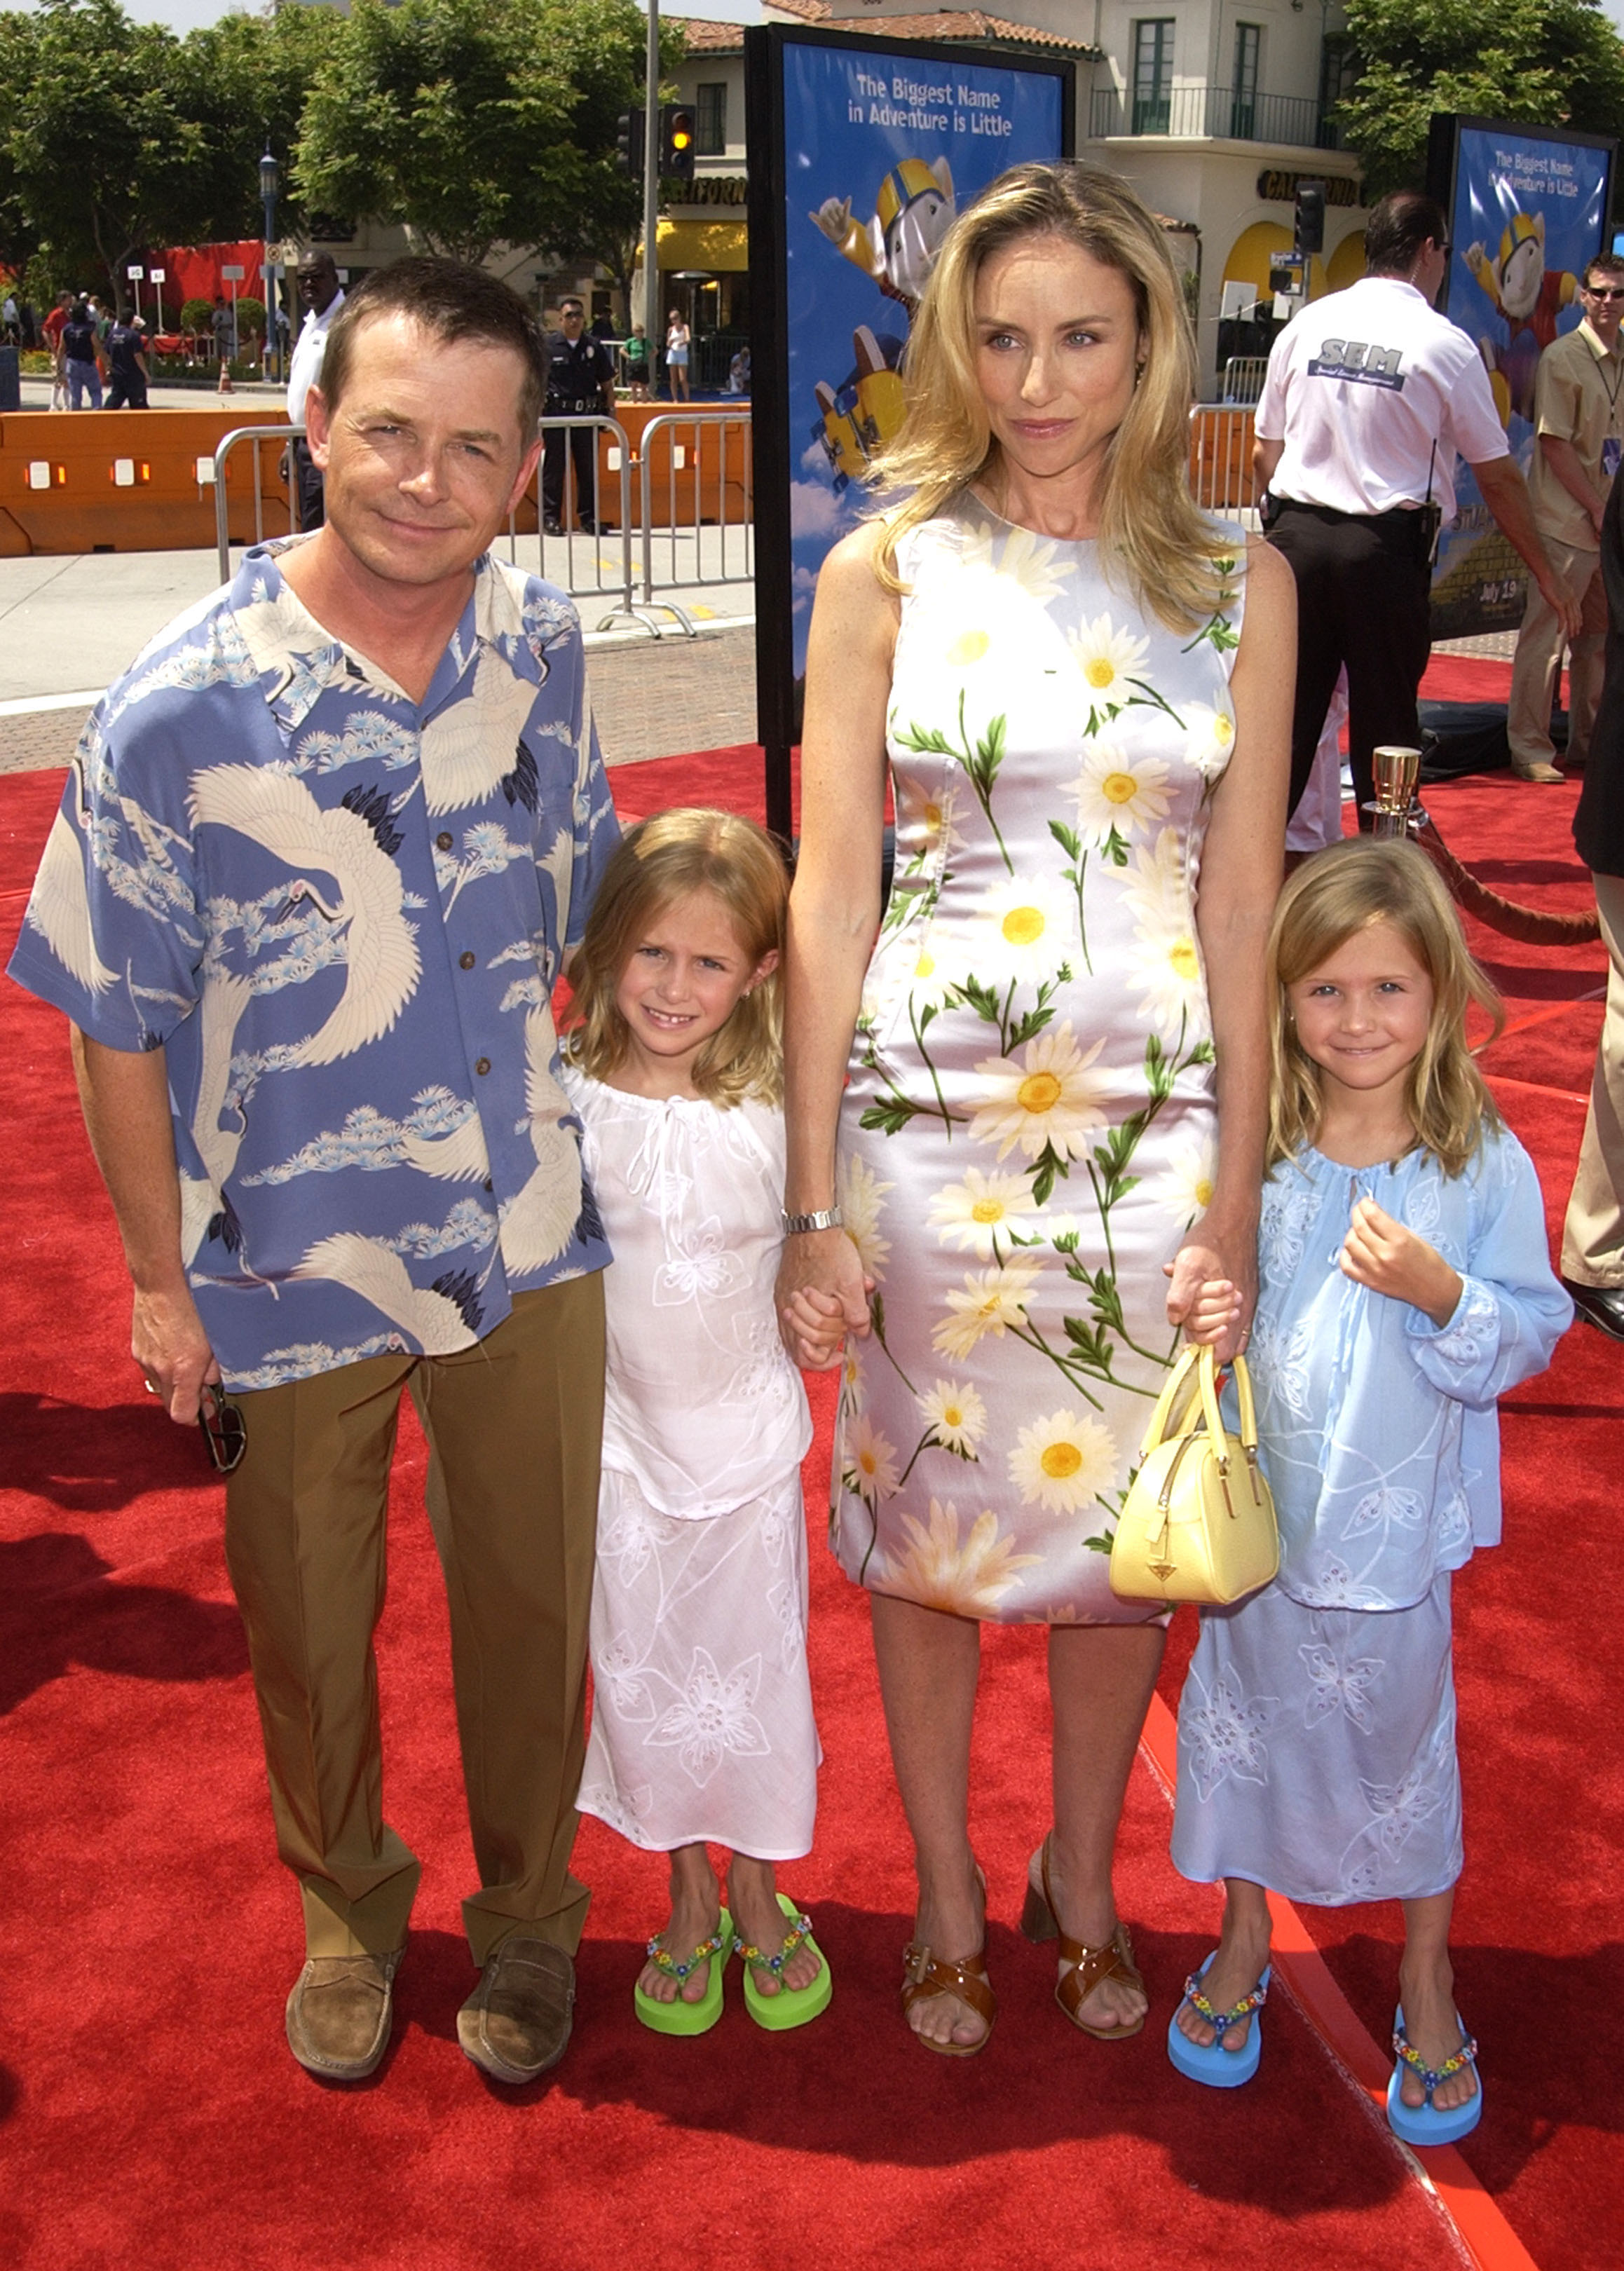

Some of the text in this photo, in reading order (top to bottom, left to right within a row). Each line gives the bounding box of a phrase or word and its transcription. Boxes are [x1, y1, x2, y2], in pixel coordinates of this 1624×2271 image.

[857, 74, 1000, 109] The Biggest Name
[848, 100, 1012, 136] in Adventure is Little
[1496, 151, 1574, 176] The Biggest Name
[1263, 172, 1358, 206] CALRNIA
[1547, 177, 1554, 194] is
[1557, 179, 1578, 197] Little
[1318, 339, 1403, 376] SEM
[1480, 580, 1516, 603] July 19
